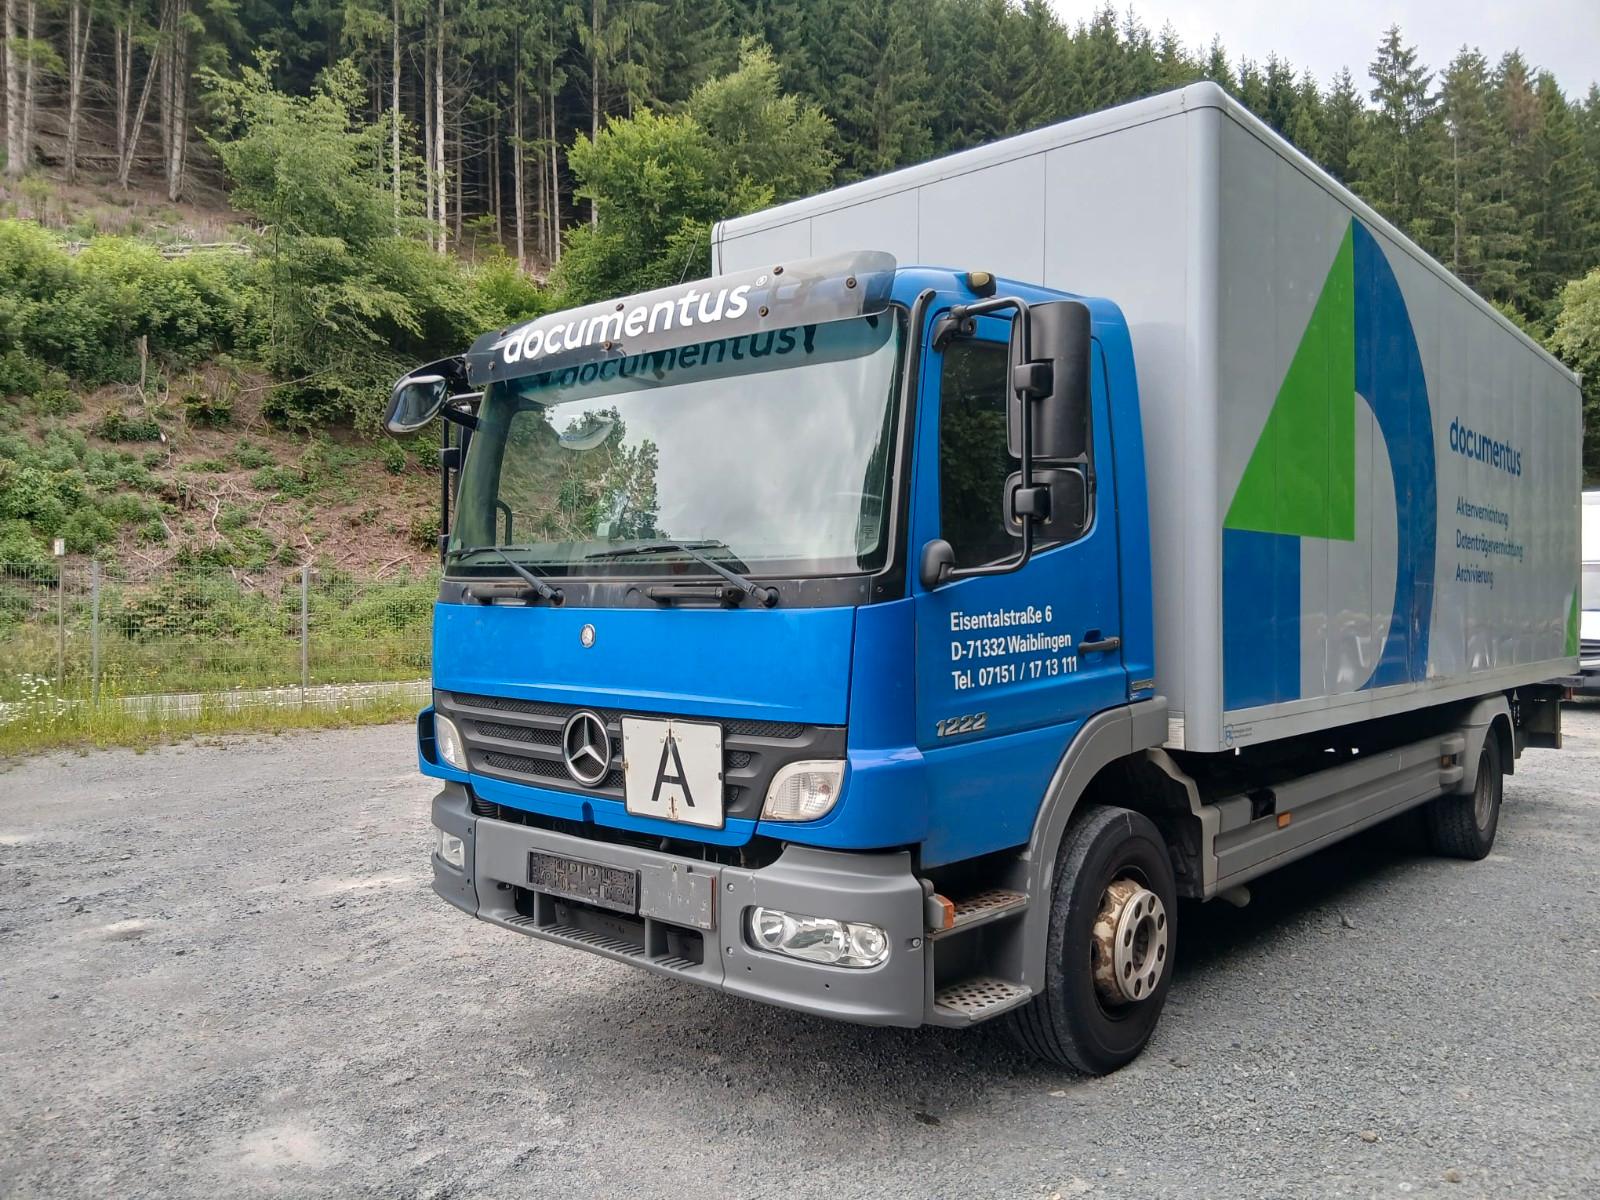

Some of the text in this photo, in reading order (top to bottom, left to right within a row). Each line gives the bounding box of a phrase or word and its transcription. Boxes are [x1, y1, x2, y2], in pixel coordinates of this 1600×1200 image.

[503, 284, 751, 364] documentus
[1450, 416, 1521, 477] documentus
[1456, 496, 1508, 531] Aktenvernichtung
[1456, 563, 1493, 590] Archivierung
[950, 605, 1053, 631] Eisentalstraße 6
[951, 632, 1072, 661] D-71332 Waiblingen
[952, 655, 1078, 690] Tel. 07151 / 17 13 111
[936, 712, 987, 737] 1222
[651, 735, 696, 808] A
